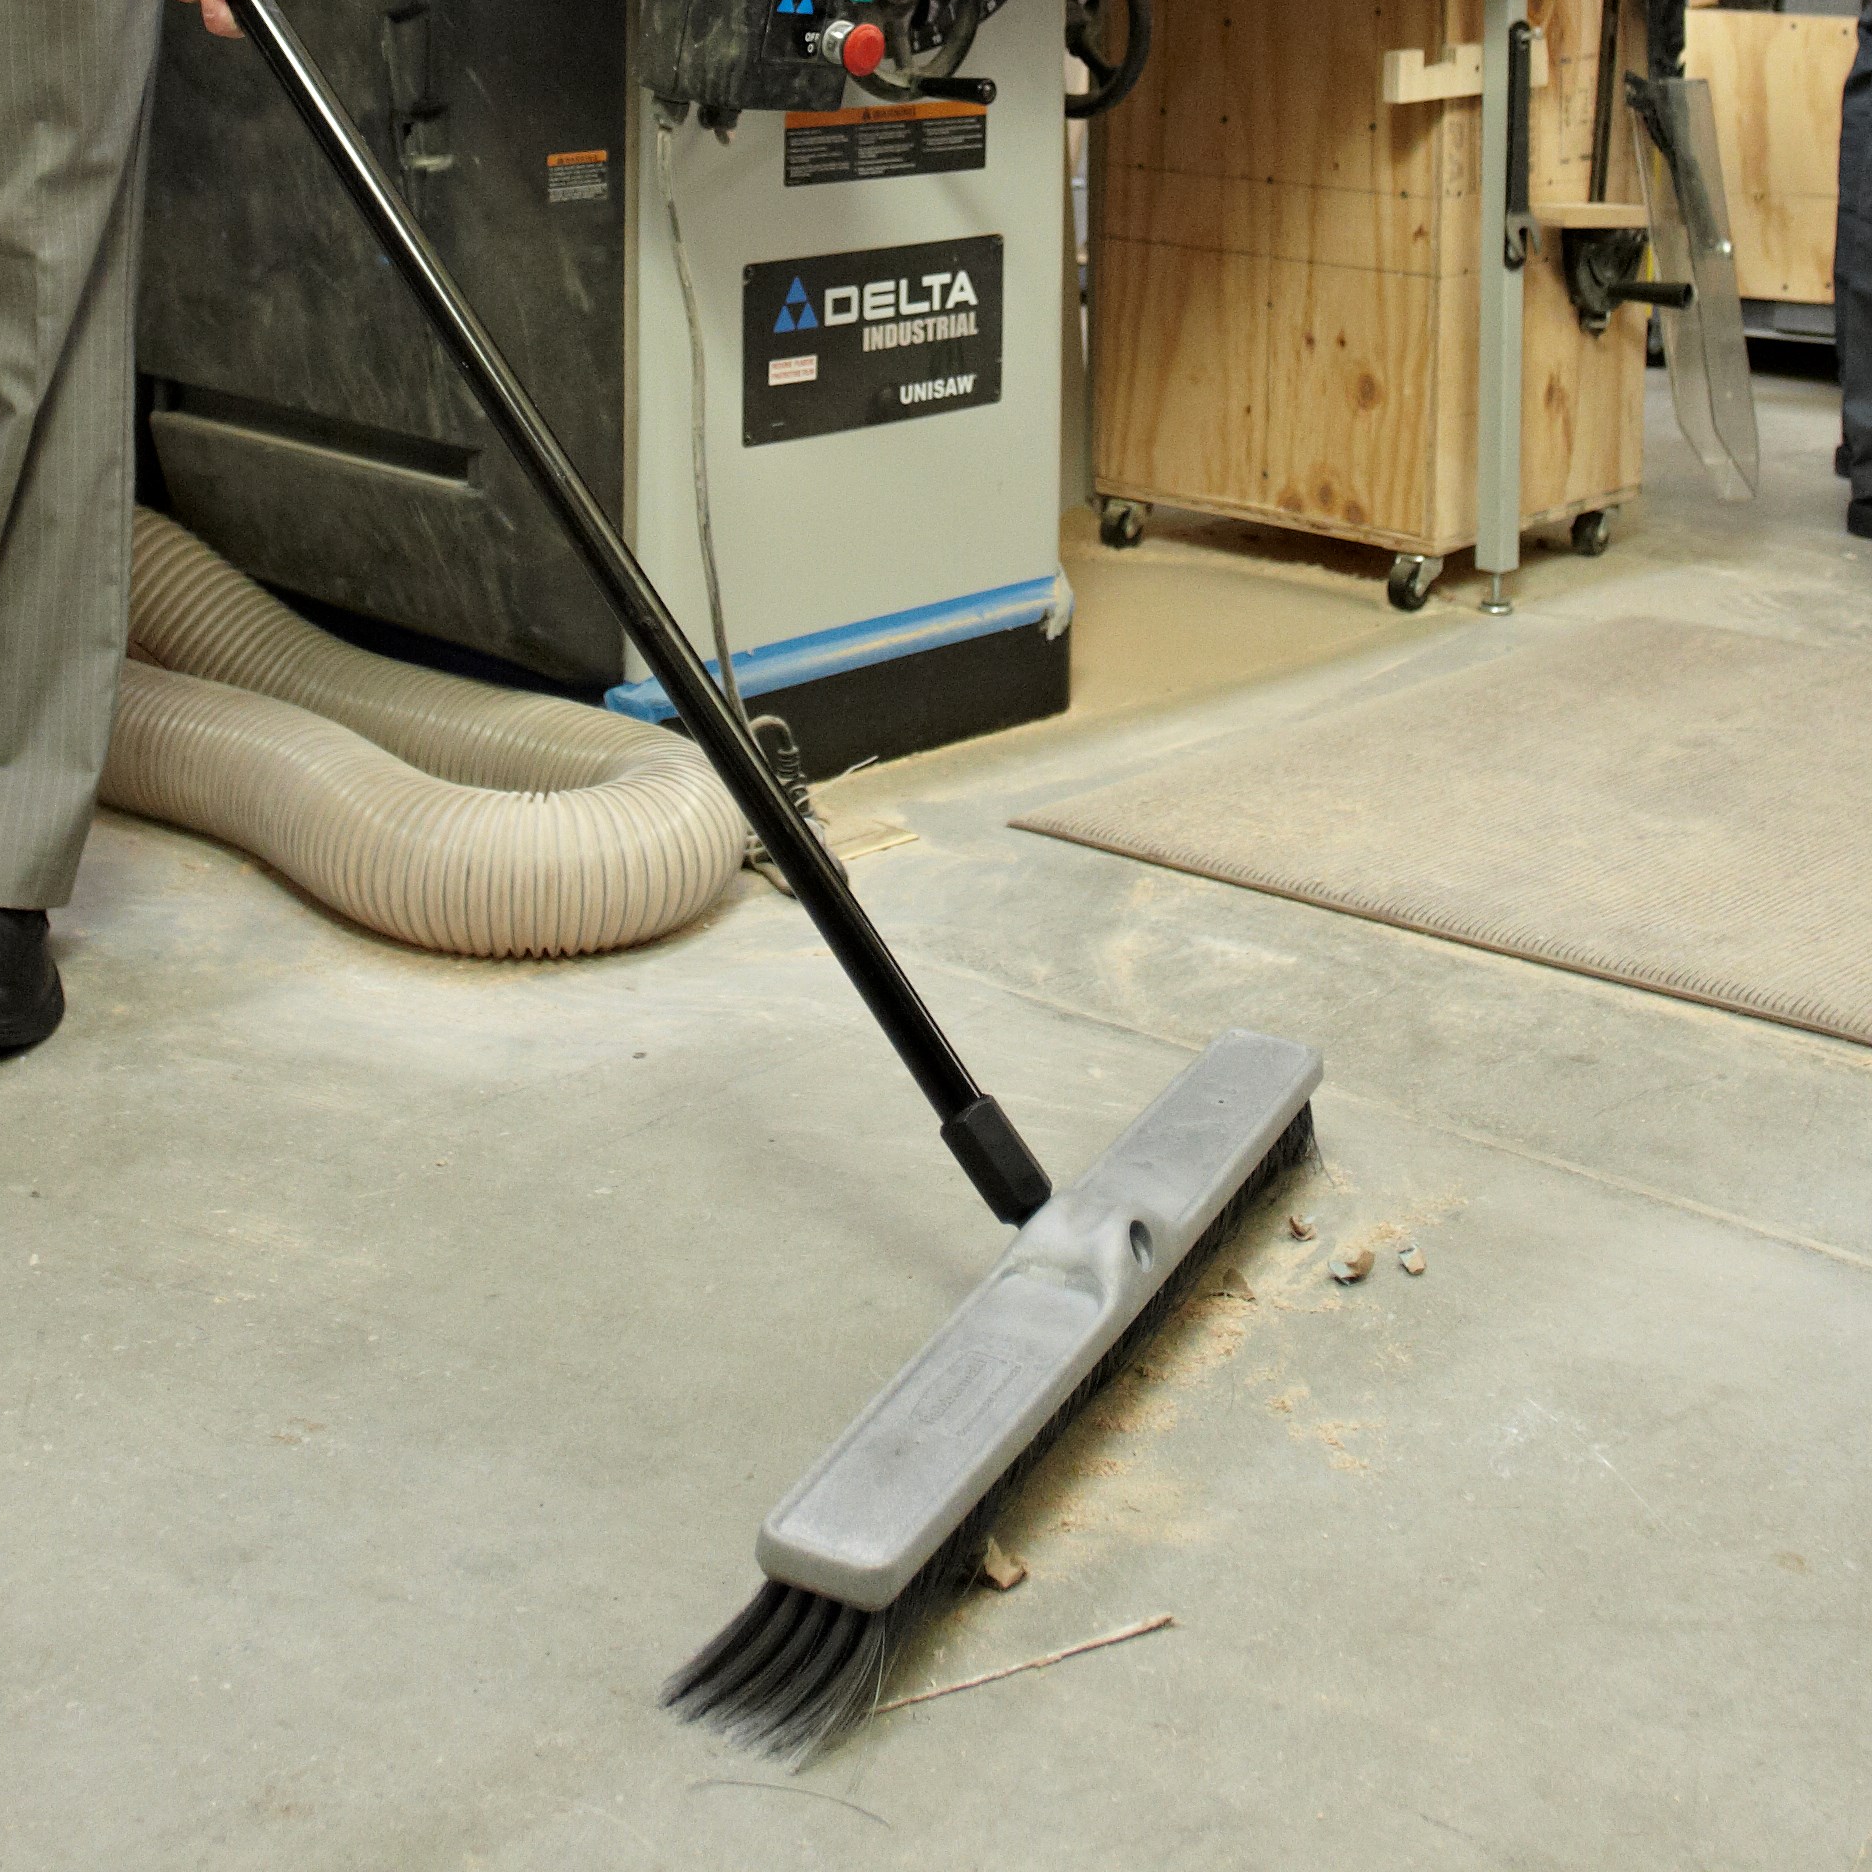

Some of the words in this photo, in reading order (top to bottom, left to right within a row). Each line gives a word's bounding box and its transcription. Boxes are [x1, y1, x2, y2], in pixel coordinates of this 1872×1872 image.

[805, 32, 821, 43] OFF
[824, 269, 979, 327] DELTA
[862, 311, 978, 353] INDUSTRIAL
[899, 373, 976, 405] UNISAW
